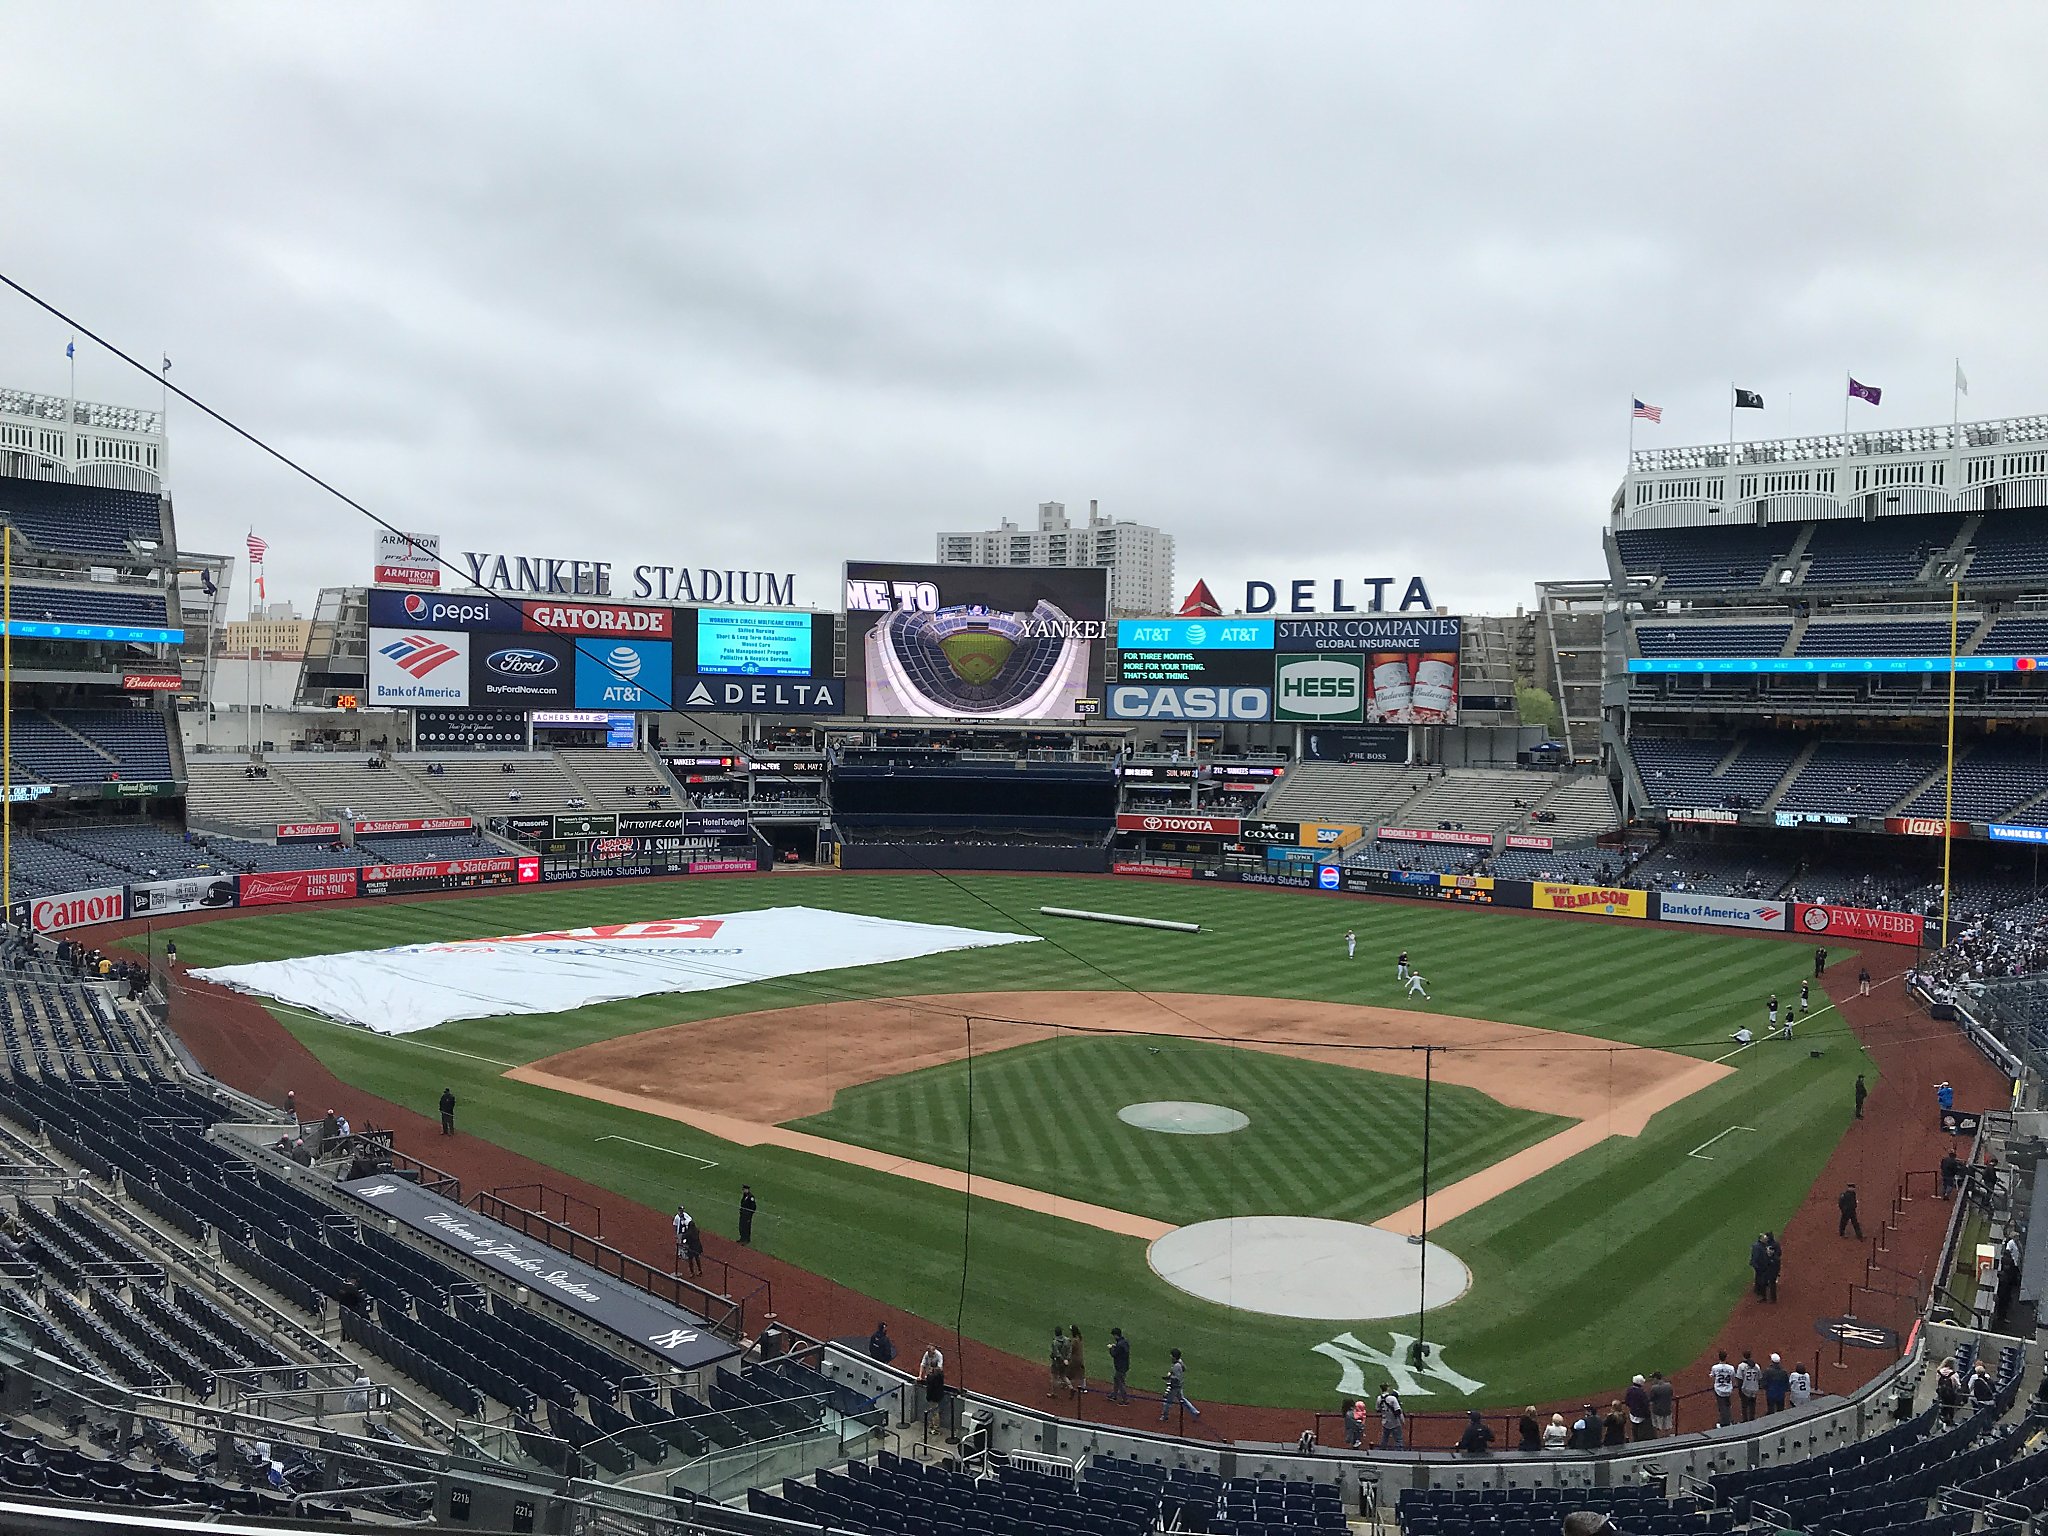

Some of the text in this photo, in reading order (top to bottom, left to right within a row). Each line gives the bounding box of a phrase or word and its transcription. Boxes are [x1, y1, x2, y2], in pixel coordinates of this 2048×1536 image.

[381, 535, 437, 548] ARMITRON
[384, 568, 434, 579] ARMITRON
[461, 551, 797, 606] YANKEE STADIUM
[892, 581, 940, 613] TO
[1246, 576, 1433, 613] DELTA
[432, 603, 489, 624] pepsi
[533, 607, 663, 632] GATORADE
[1279, 619, 1459, 638] STARR COMPANIES
[1134, 628, 1259, 642] AT&T AT&T
[1316, 638, 1420, 649] GLOBAL INSURANCE
[500, 653, 544, 673] Ford
[1163, 653, 1195, 661] MONTHS.
[1181, 663, 1205, 671] THING.
[124, 676, 181, 688] Budweiser
[1165, 672, 1189, 680] THING.
[377, 685, 461, 698] Bank of America
[486, 685, 558, 695] BuyFordNow.com
[1284, 677, 1355, 698] HESS
[603, 687, 643, 701] AT&T
[725, 683, 834, 706] DELTA
[1113, 687, 1268, 719] CASIO
[673, 758, 696, 766] YANKEES
[1349, 752, 1387, 760] THE BOSS
[1226, 767, 1249, 775] YANKEES
[118, 783, 158, 793] Poland Spring
[1667, 808, 1692, 819] Parts
[1693, 808, 1738, 821] Authority
[1806, 814, 1820, 823] OUR
[513, 819, 549, 827] Panasonic
[618, 818, 682, 830] NITTOTIRE.COM
[1163, 819, 1213, 831] TOYOTA
[1244, 830, 1295, 840] COACH
[1317, 830, 1338, 841] SAP
[1381, 829, 1489, 843] MODELL'S MODELLS.com
[1993, 828, 2043, 839] YANKEES
[644, 839, 652, 854] A
[1223, 842, 1246, 852] FedEx
[1510, 837, 1549, 846] MODELL'S
[307, 872, 355, 885] THIS BUD'S
[545, 866, 651, 881] StubHub StubHub StubHub
[1242, 873, 1310, 886] StubHub StubHub
[1410, 873, 1430, 882] pepsi
[175, 886, 199, 894] ON-FIELD
[248, 884, 297, 894] Budweiser
[307, 884, 347, 896] FOR YOU.
[1579, 890, 1629, 907] MASON
[32, 893, 122, 931] Canon
[1662, 903, 1750, 920] Bank of America
[1831, 910, 1915, 934] F.W. WEBB
[1924, 920, 1936, 929] 314
[424, 1212, 601, 1303] Welcome to Yankee Stadium
[1717, 1374, 1731, 1384] 24
[1746, 1371, 1757, 1382] 27
[1799, 1382, 1807, 1391] 2
[452, 1491, 470, 1504] 221b
[515, 1505, 533, 1518] 221a
